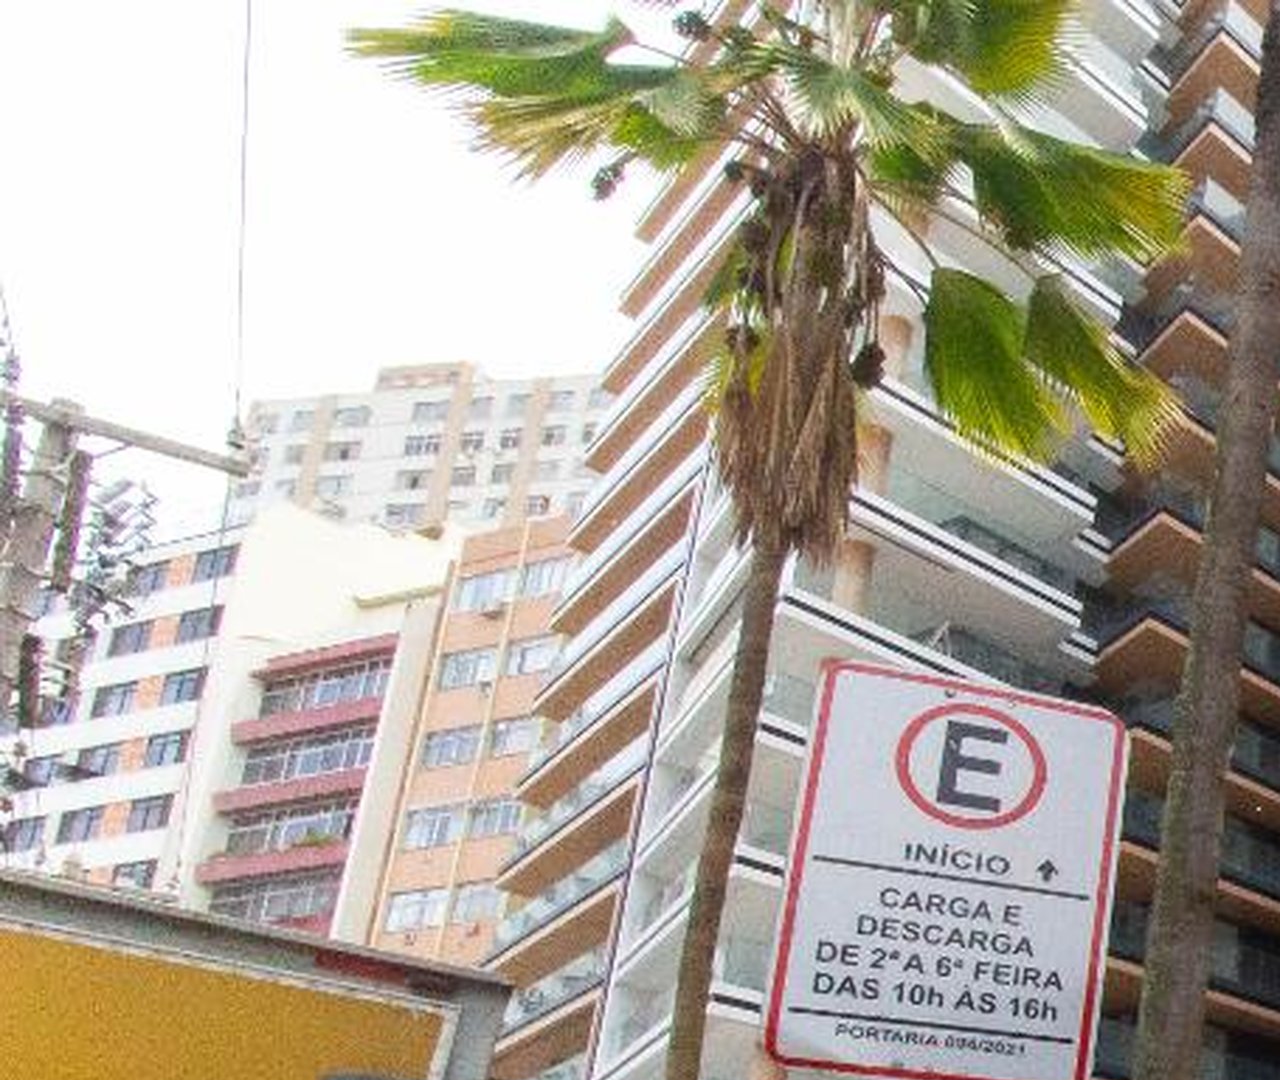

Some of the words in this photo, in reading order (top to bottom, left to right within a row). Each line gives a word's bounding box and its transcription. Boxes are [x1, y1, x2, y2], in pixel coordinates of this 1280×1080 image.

[936, 720, 1009, 813] E
[904, 843, 1011, 876] INÍCIO
[879, 887, 992, 922] CARGA
[1003, 904, 1022, 926] E
[857, 913, 1034, 958] DESCARGA
[816, 941, 861, 967] DE
[973, 964, 1063, 992] FEIRA
[812, 972, 881, 1001] DAS
[893, 983, 945, 1010] 10h
[1009, 994, 1059, 1023] 16h
[834, 1023, 938, 1048] PORTARIA
